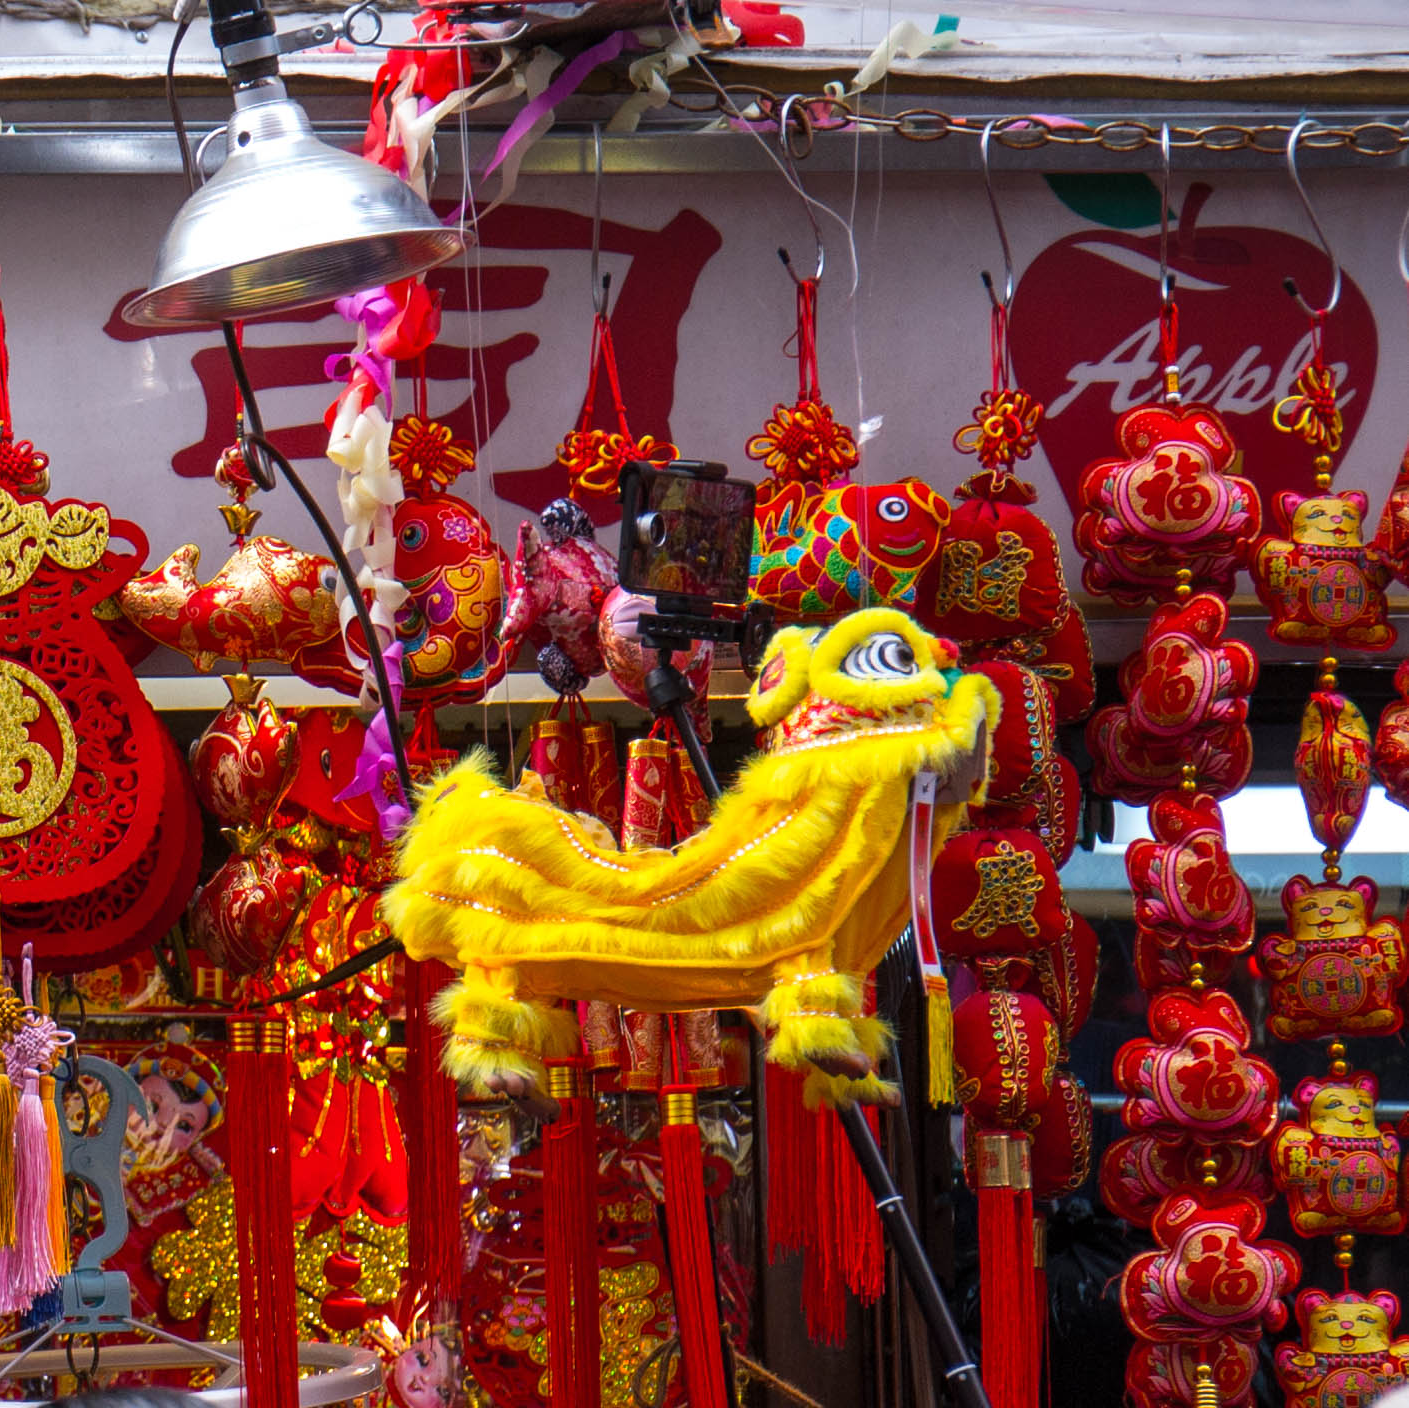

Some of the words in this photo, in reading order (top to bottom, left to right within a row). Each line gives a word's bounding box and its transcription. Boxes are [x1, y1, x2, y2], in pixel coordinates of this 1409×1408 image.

[1135, 452, 1212, 522] 福
[1176, 1039, 1246, 1110] 福
[1186, 1233, 1259, 1306] 福
